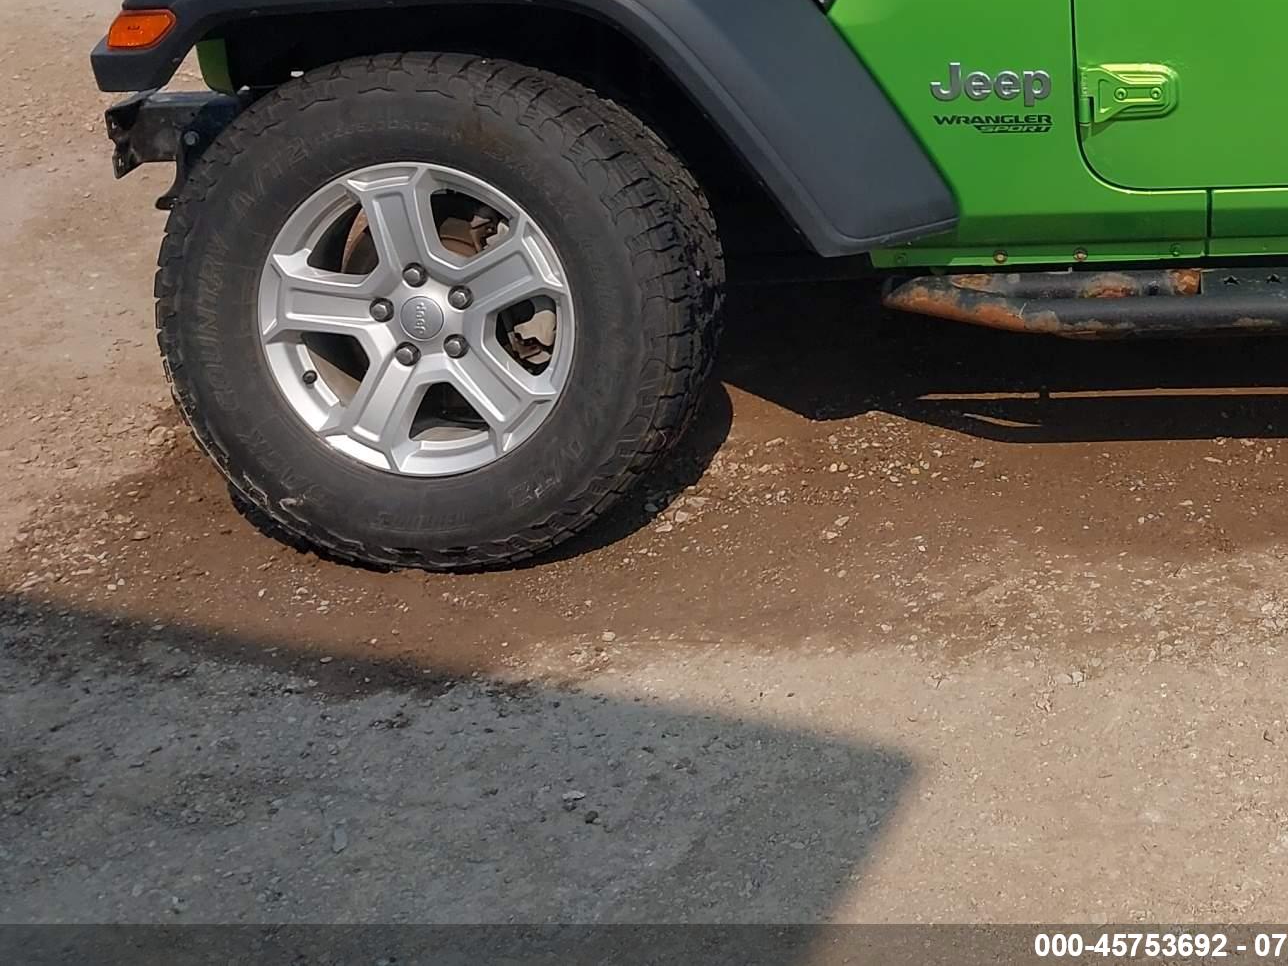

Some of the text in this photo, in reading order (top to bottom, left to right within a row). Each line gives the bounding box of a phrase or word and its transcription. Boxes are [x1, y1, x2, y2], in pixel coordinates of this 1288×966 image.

[930, 62, 1051, 107] Jeep
[933, 115, 1052, 125] WRANGLER
[979, 125, 1050, 133] SPORT
